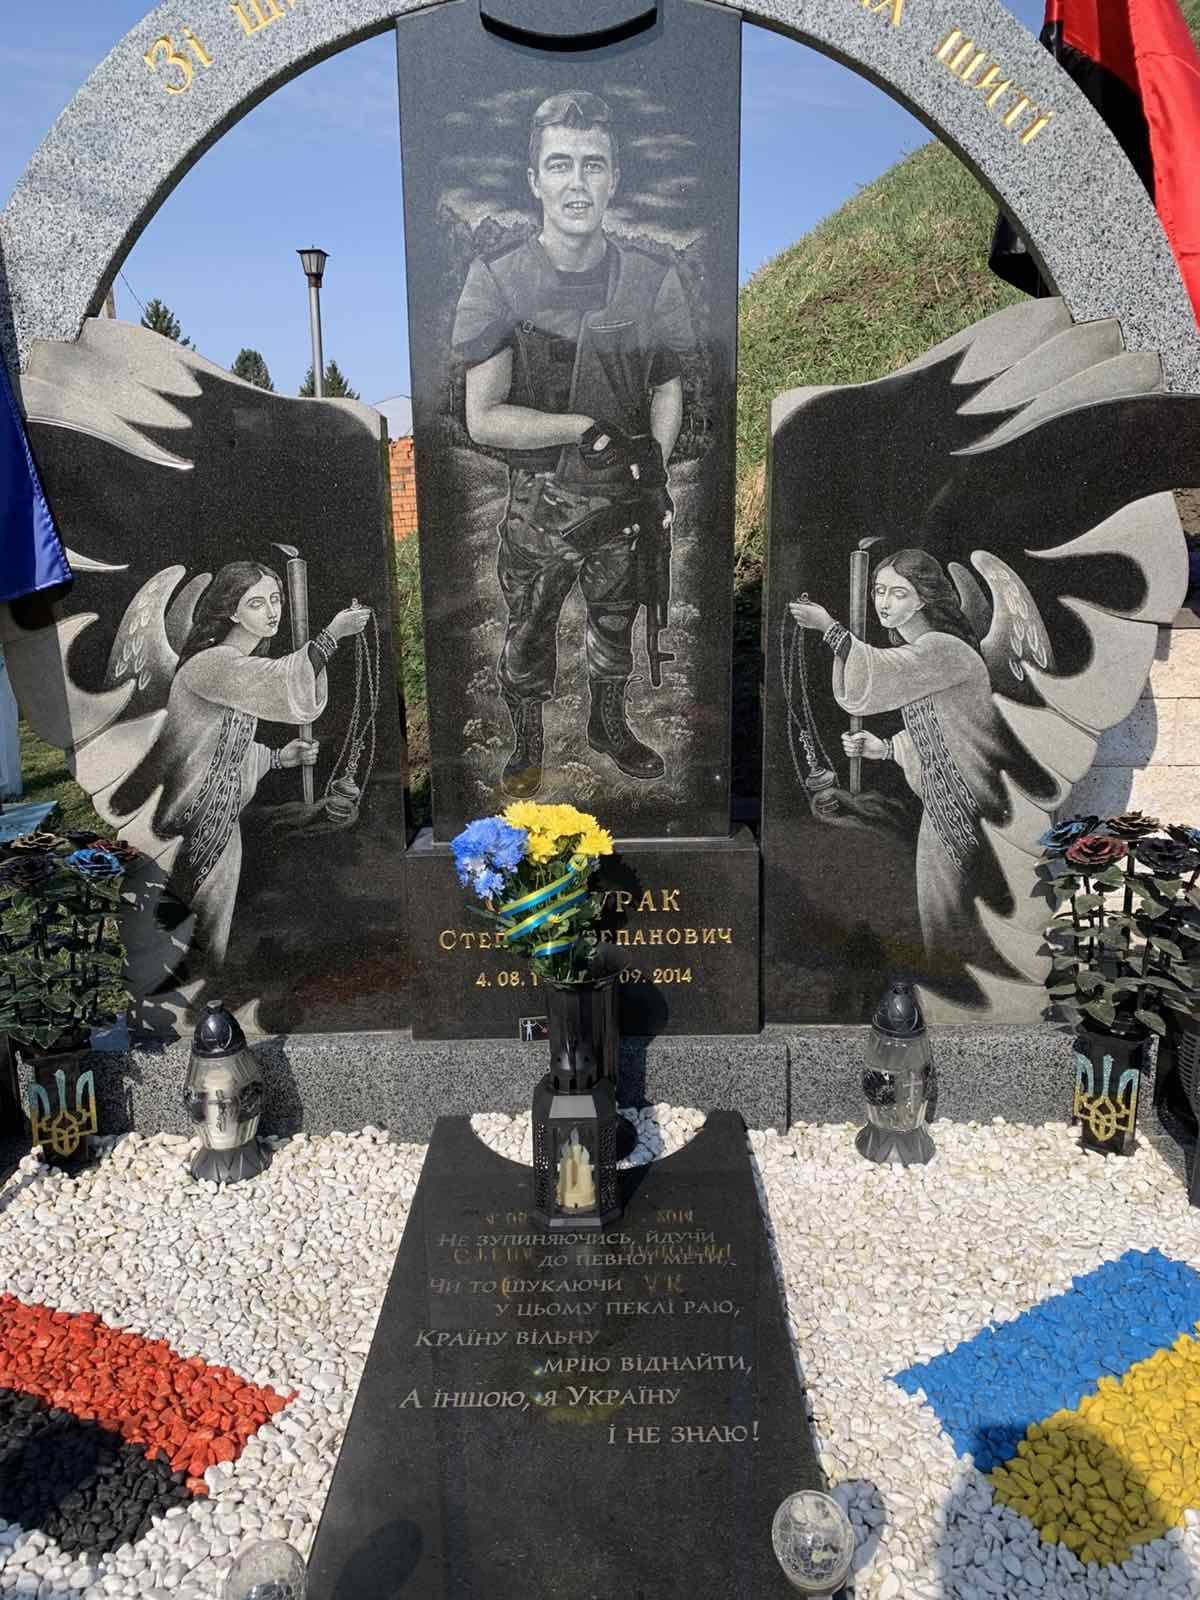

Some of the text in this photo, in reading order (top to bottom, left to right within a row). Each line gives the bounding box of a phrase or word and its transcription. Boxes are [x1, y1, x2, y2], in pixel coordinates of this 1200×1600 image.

[590, 888, 681, 913] УРАК
[600, 927, 734, 946] ЕПАНОВИЧ
[652, 967, 693, 984] 2014
[537, 1254, 569, 1268] ДО
[495, 1302, 510, 1317] У
[517, 1302, 599, 1317] ЦЬОМУ
[684, 1300, 742, 1318] РАЮ,
[415, 1328, 600, 1347] КРАЇНУ ВІЛЬНУ
[543, 1352, 753, 1375] МРІЮ ВІДНАЙТИ,
[400, 1385, 681, 1412] А ІНШОЮ, Я УКРАЇНУ
[607, 1423, 617, 1444] І
[626, 1426, 661, 1445] НЕ
